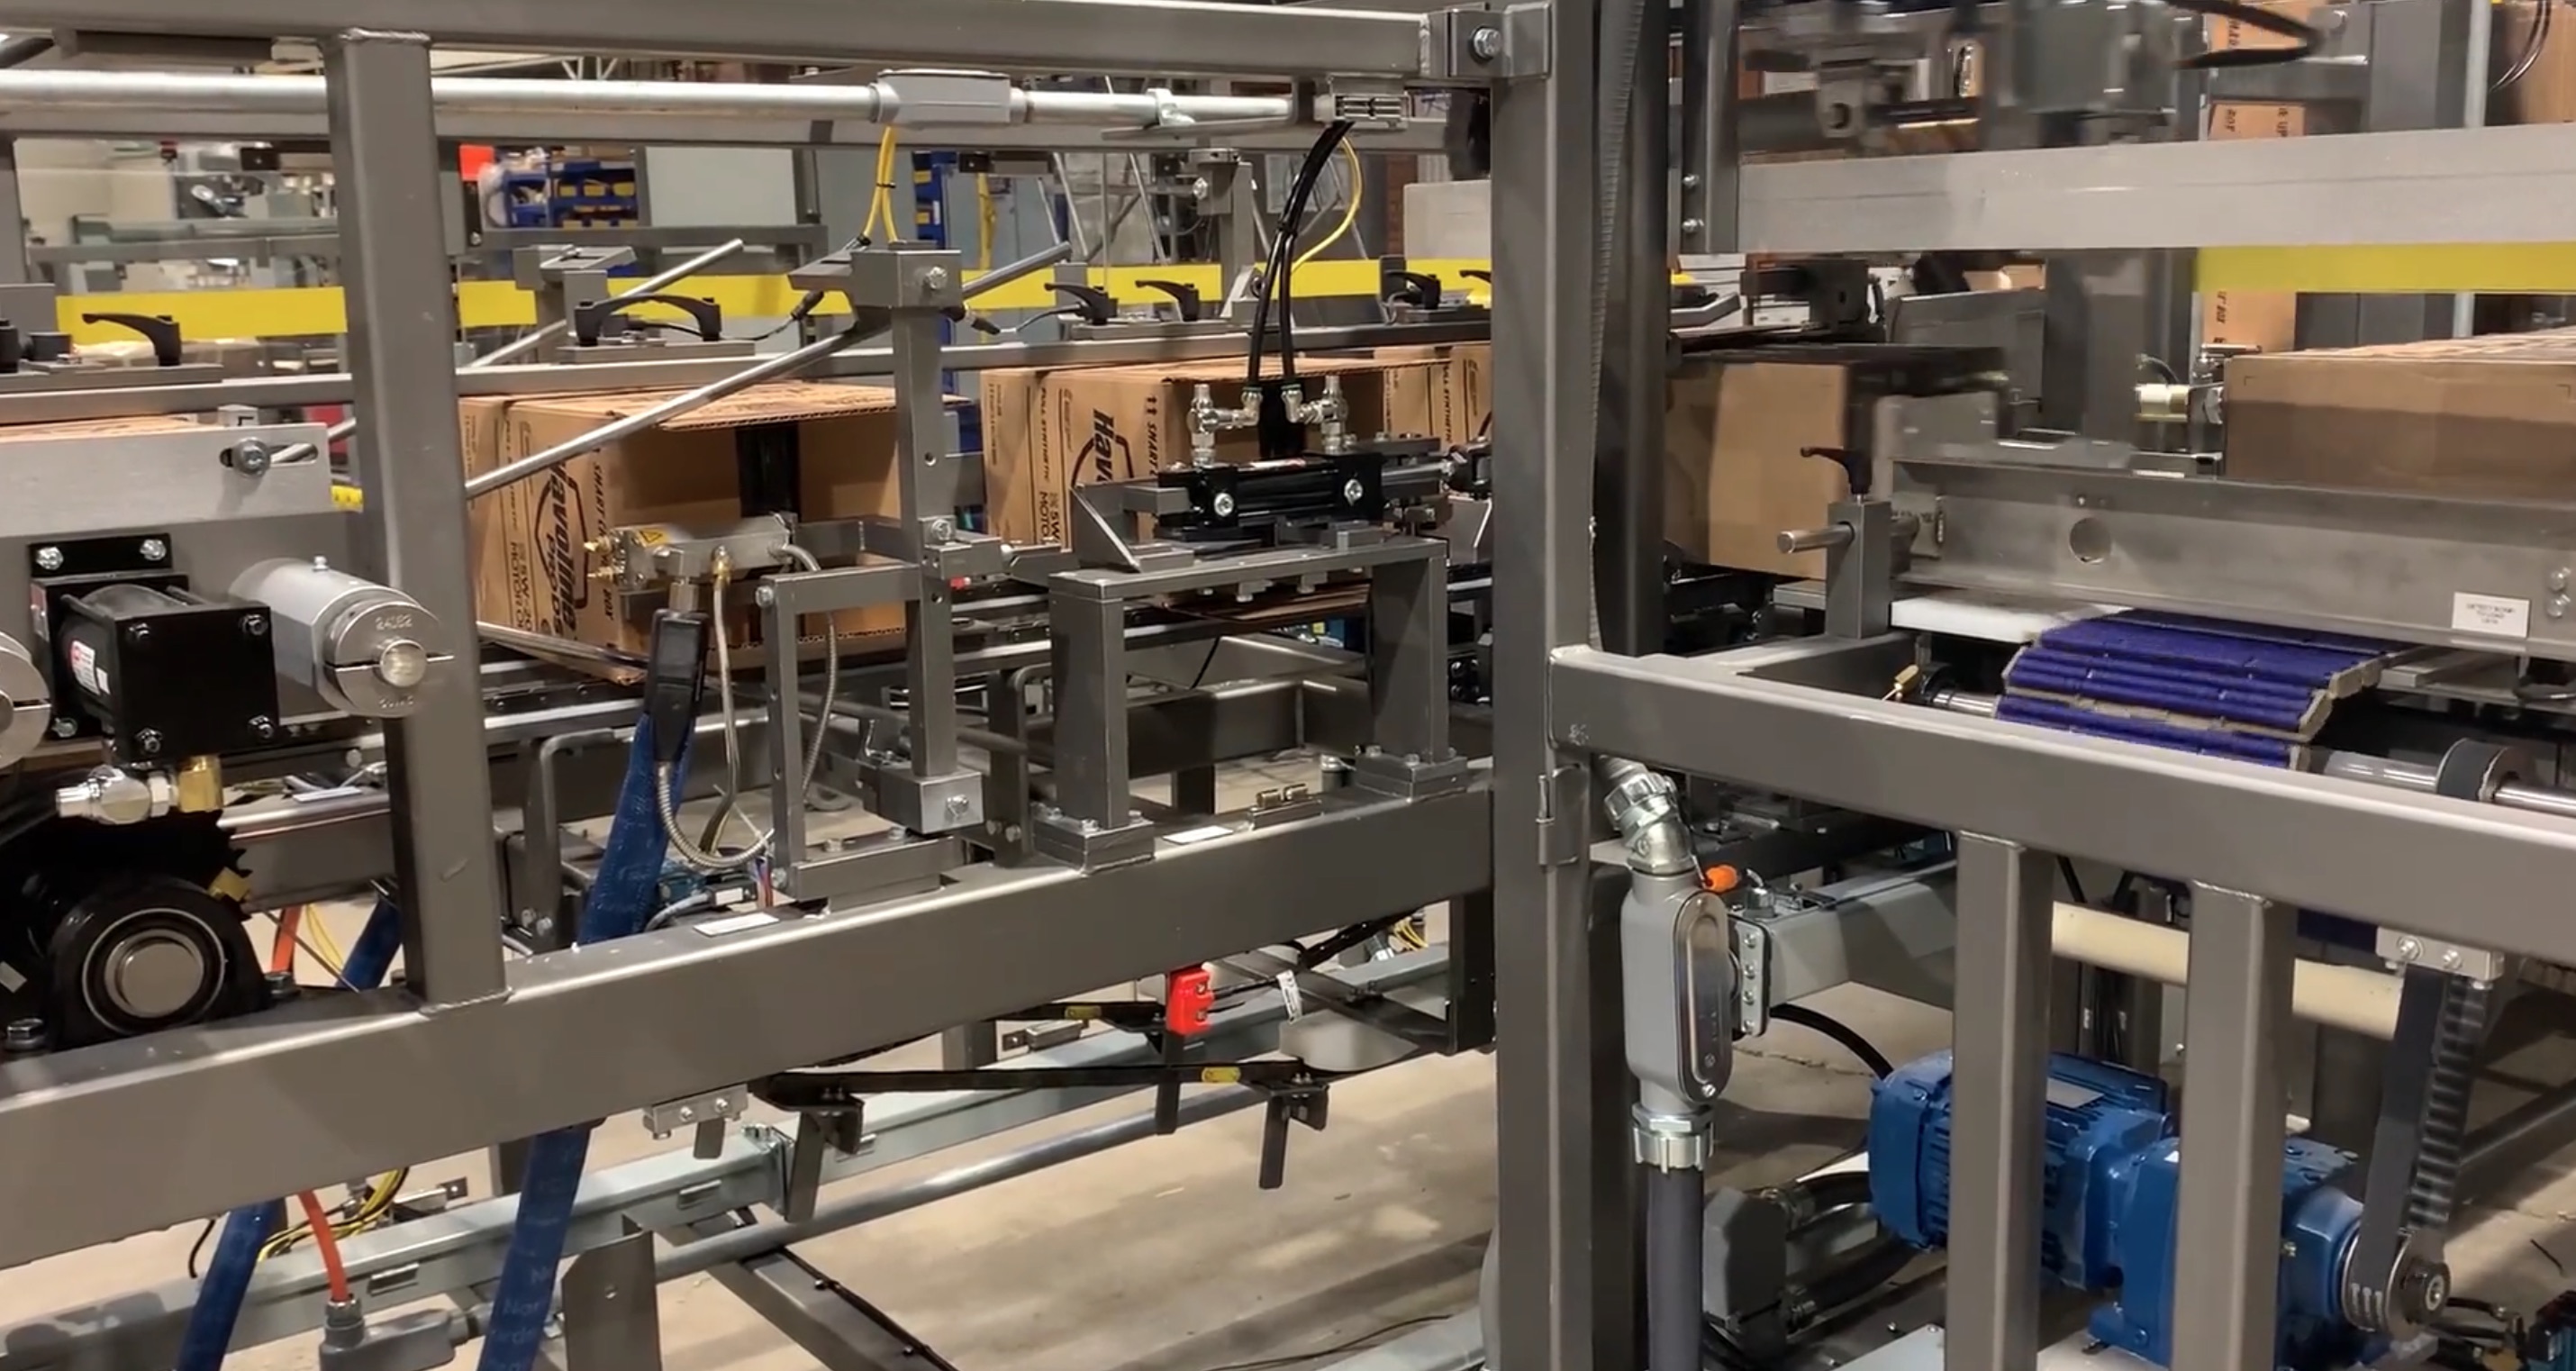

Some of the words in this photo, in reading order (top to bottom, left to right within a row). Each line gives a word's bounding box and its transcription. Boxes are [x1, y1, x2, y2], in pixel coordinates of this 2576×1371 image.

[1147, 422, 1159, 470] SMART
[594, 462, 605, 518] SMART
[1039, 491, 1050, 539] MOTO
[1050, 511, 1060, 540] 5W
[511, 541, 524, 607] MOTOR
[516, 609, 525, 629] OI
